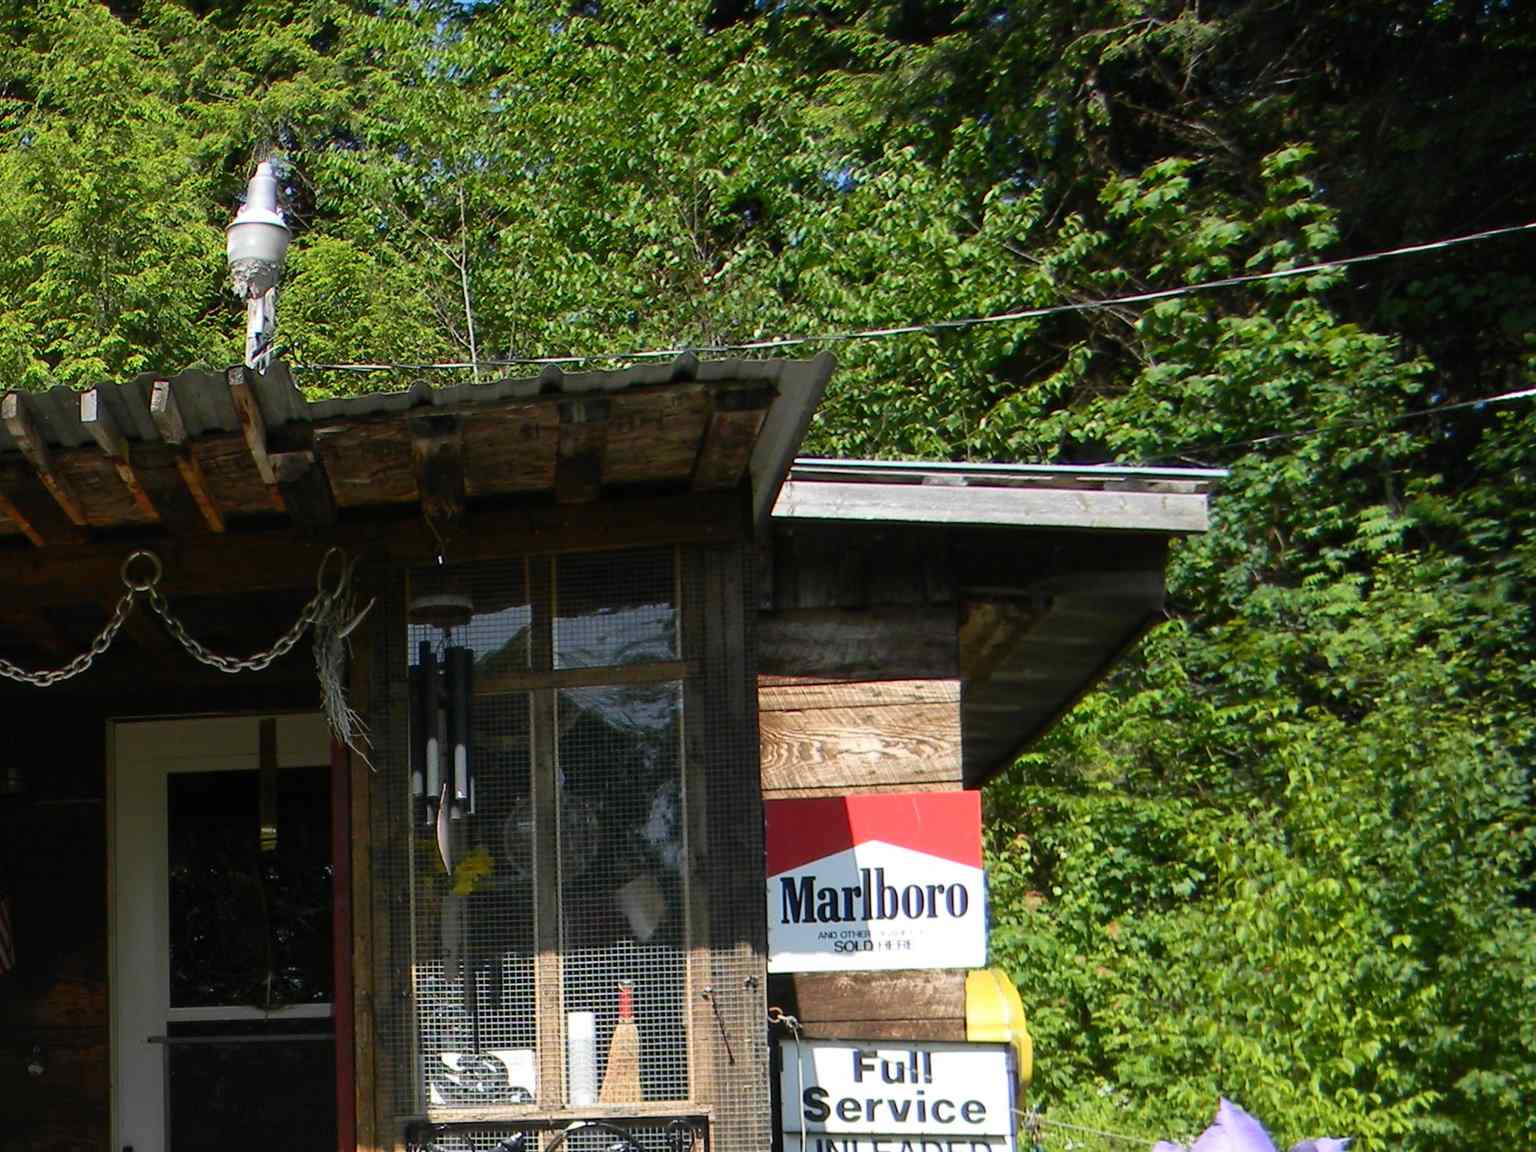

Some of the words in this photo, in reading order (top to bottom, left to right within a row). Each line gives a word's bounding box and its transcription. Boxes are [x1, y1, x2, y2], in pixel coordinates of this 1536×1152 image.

[780, 868, 969, 924] Marlboro
[817, 929, 837, 940] AND
[840, 929, 871, 939] OTHER
[834, 940, 874, 952] SOLD
[852, 1050, 933, 1084] Full
[803, 1086, 987, 1124] Service
